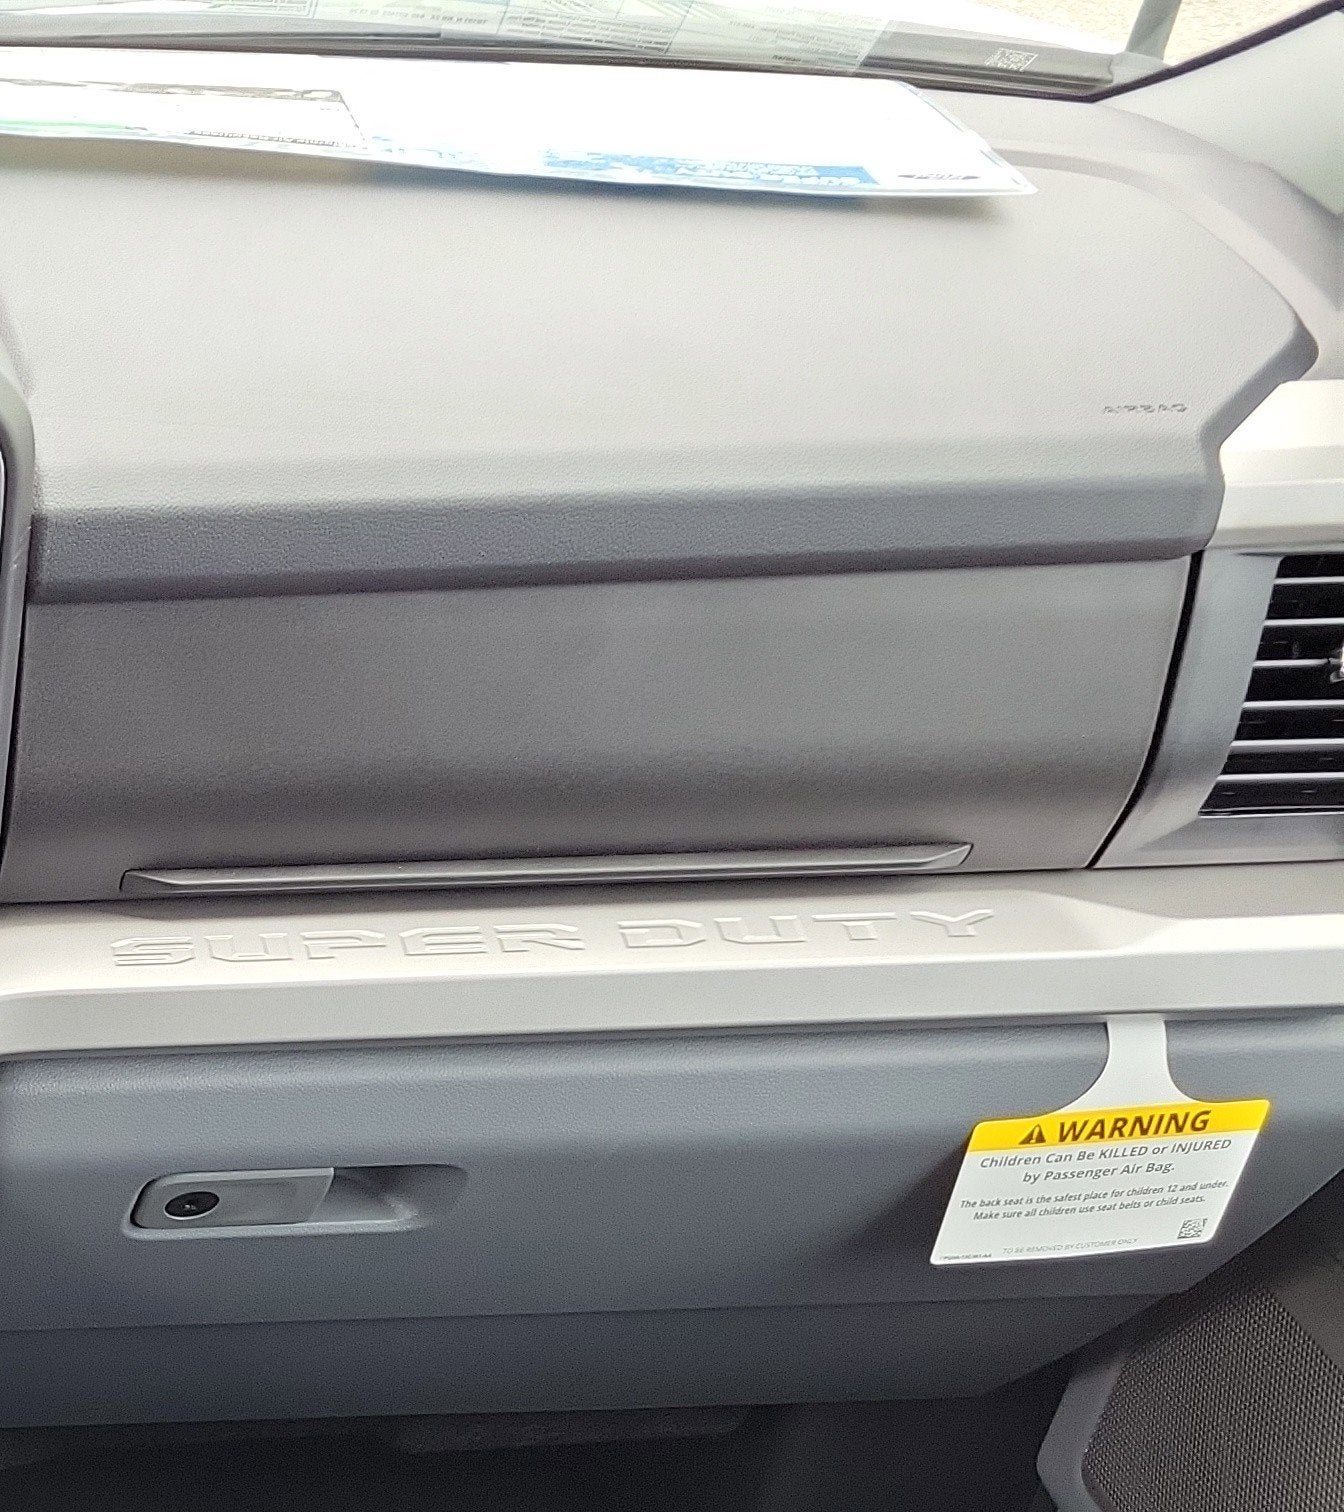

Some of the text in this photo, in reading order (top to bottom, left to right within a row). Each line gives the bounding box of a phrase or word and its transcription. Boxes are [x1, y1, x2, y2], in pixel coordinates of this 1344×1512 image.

[109, 907, 998, 968] SUPER DUTY
[1059, 1110, 1211, 1142] WARNING
[980, 1139, 1231, 1168] Children Can Be KILLED or INJURED
[1023, 1162, 1174, 1184] by Passenger Air Bag.
[961, 1200, 976, 1208] The
[979, 1199, 1000, 1207] back
[1004, 1197, 1023, 1205] seat
[1036, 1195, 1051, 1203] the
[1054, 1192, 1081, 1202] safest
[1084, 1191, 1107, 1201] place
[1111, 1188, 1123, 1198] for
[1126, 1187, 1163, 1196] children
[1179, 1183, 1198, 1191] and
[1199, 1180, 1228, 1189] under.
[973, 1211, 999, 1220] Make
[1025, 1208, 1037, 1216] all
[1038, 1206, 1076, 1215] children
[1119, 1200, 1140, 1209] belts
[1156, 1197, 1177, 1206] child
[1179, 1196, 1205, 1204] seats.
